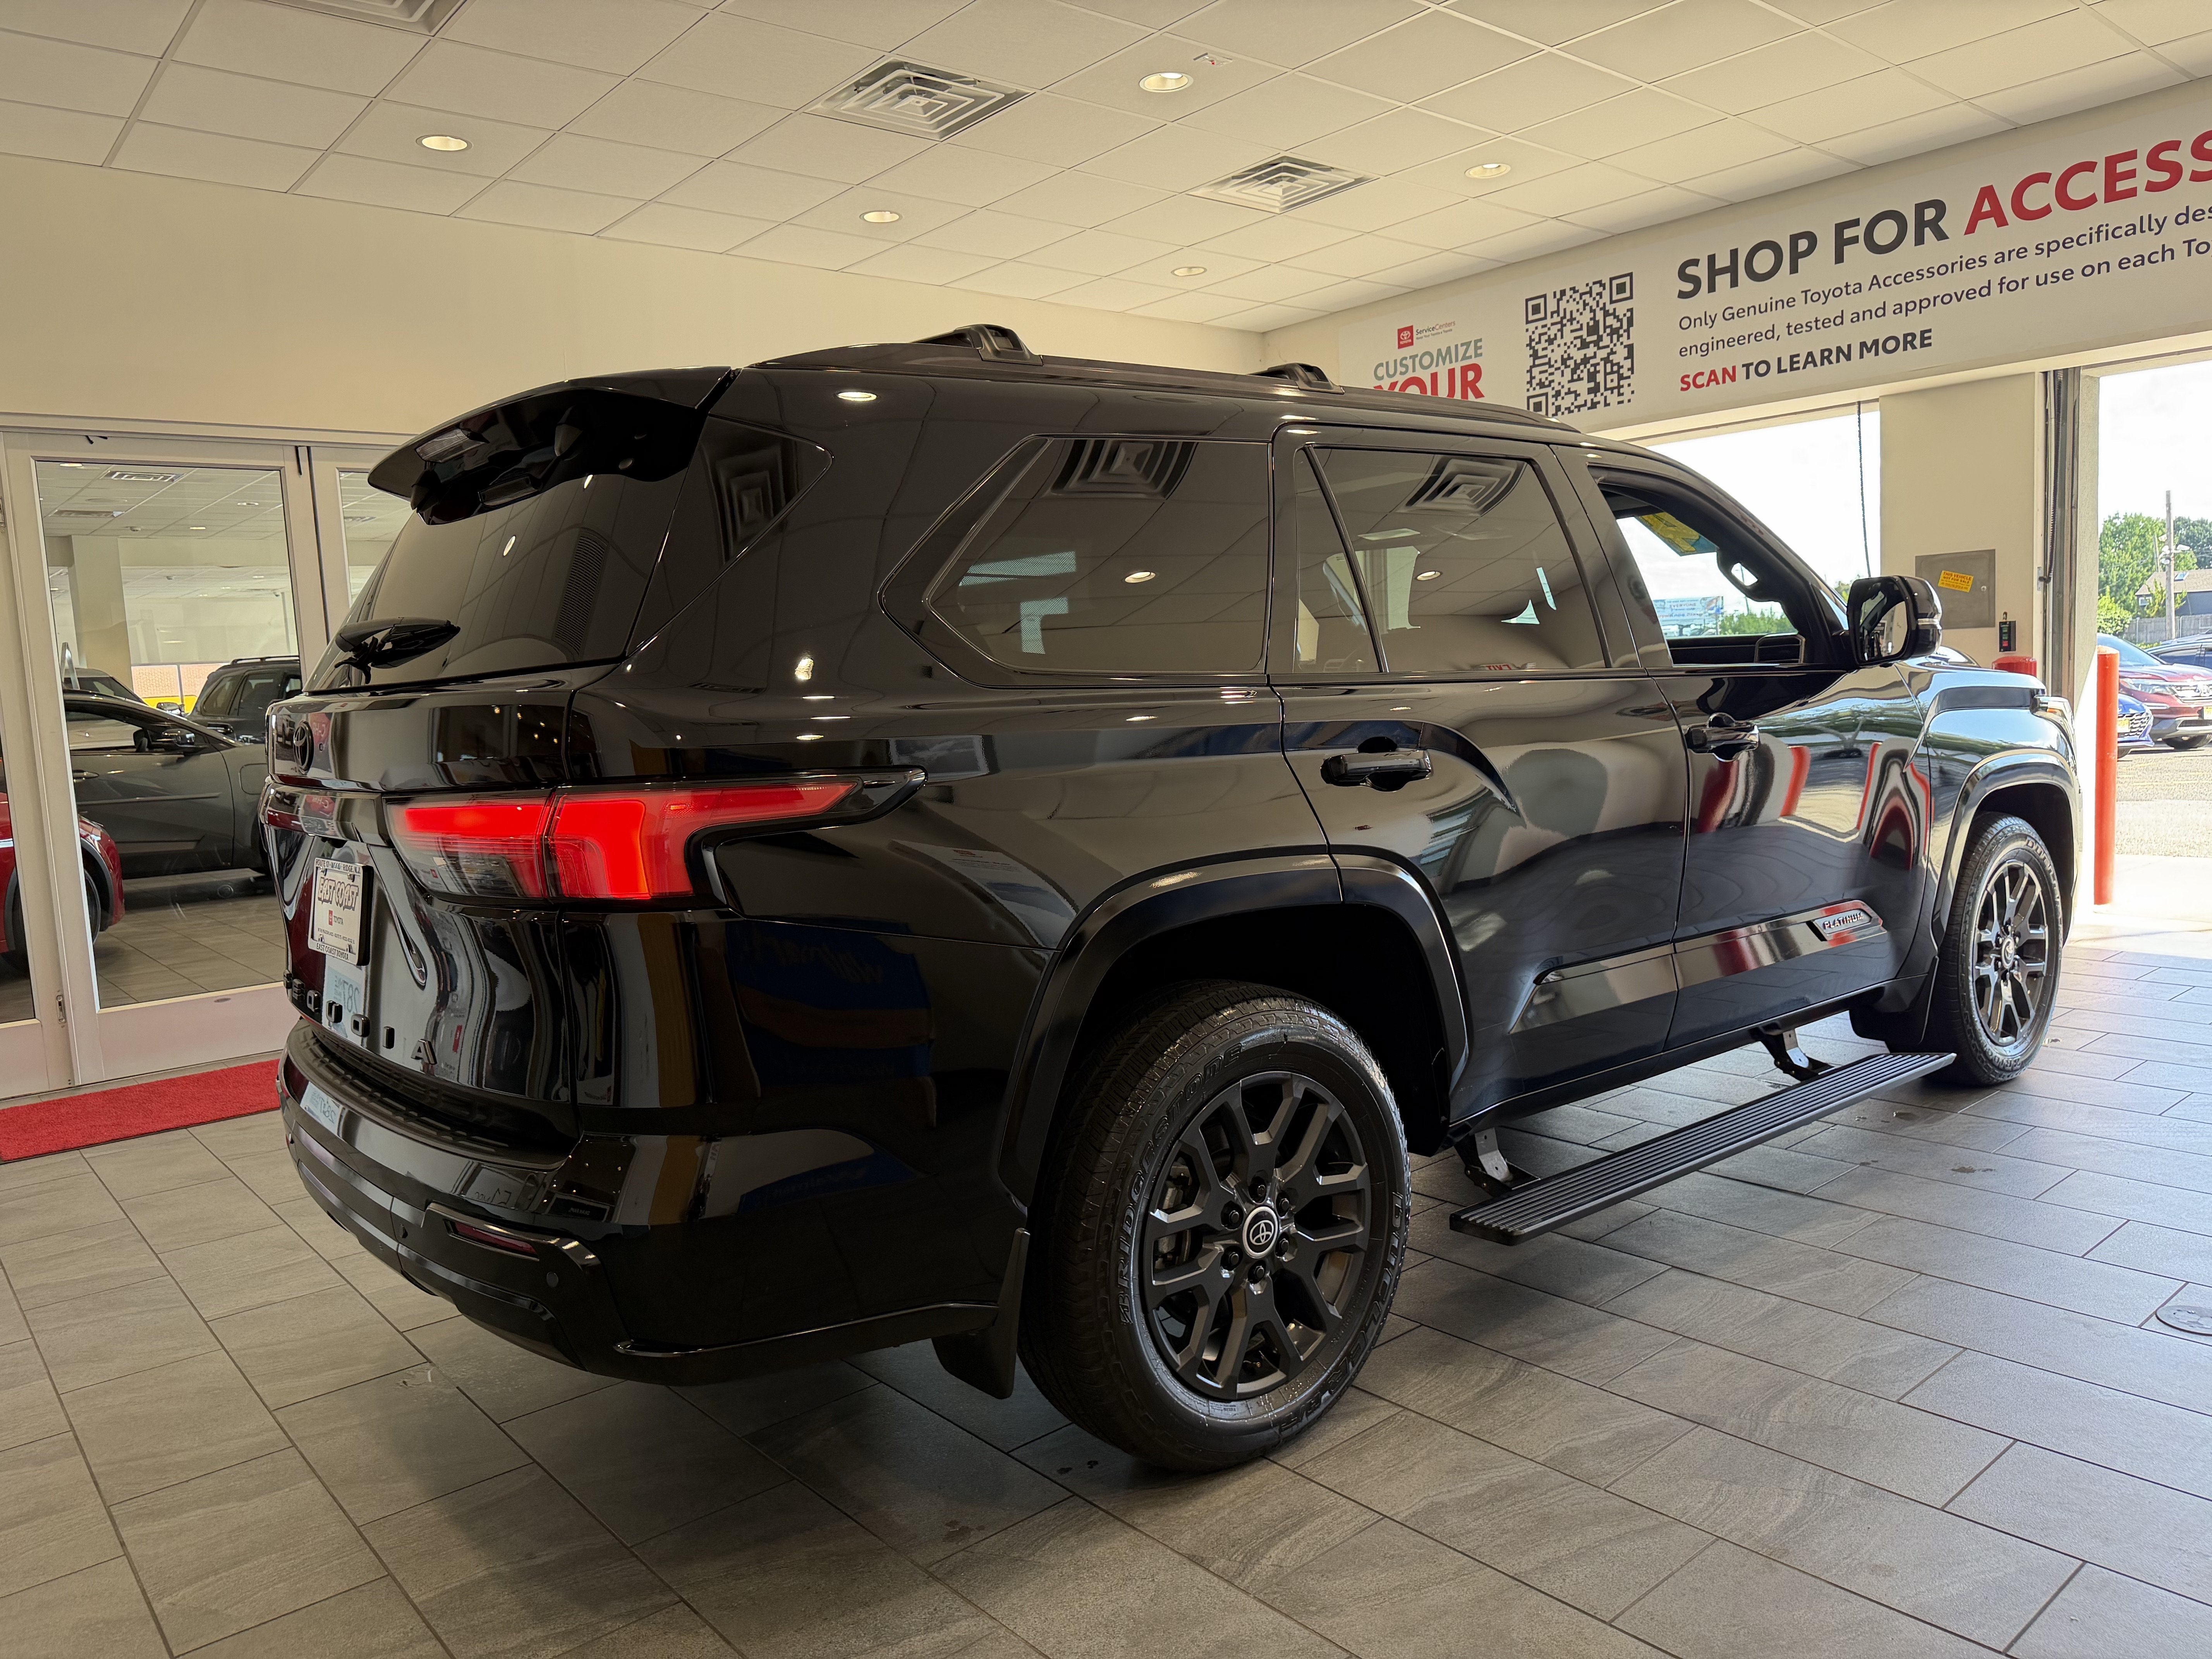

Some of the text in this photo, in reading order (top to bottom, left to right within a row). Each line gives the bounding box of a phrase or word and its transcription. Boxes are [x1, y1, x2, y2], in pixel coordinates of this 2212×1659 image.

[1677, 129, 2212, 299] SHOP FOR ACCESS
[1679, 310, 1717, 330] Only
[1722, 296, 1796, 322] Genuine
[1801, 281, 1862, 305] Toyota
[1868, 255, 1987, 291] Accessories
[1994, 246, 2028, 264] are
[2035, 213, 2168, 258] specifically
[1679, 238, 2212, 357] engineered, tested and approved for use on each To
[1416, 321, 1456, 335] ServiceCenters
[1374, 338, 1483, 381] CUSTOMIZE
[1680, 328, 1932, 392] SCAN TO LEARN MORE
[318, 876, 359, 911] EAST COAST
[1823, 912, 1864, 929] PLATINUM
[316, 943, 349, 960] EAST COAST TOYOTA
[1118, 1041, 1243, 1325] BRIDGESTONE
